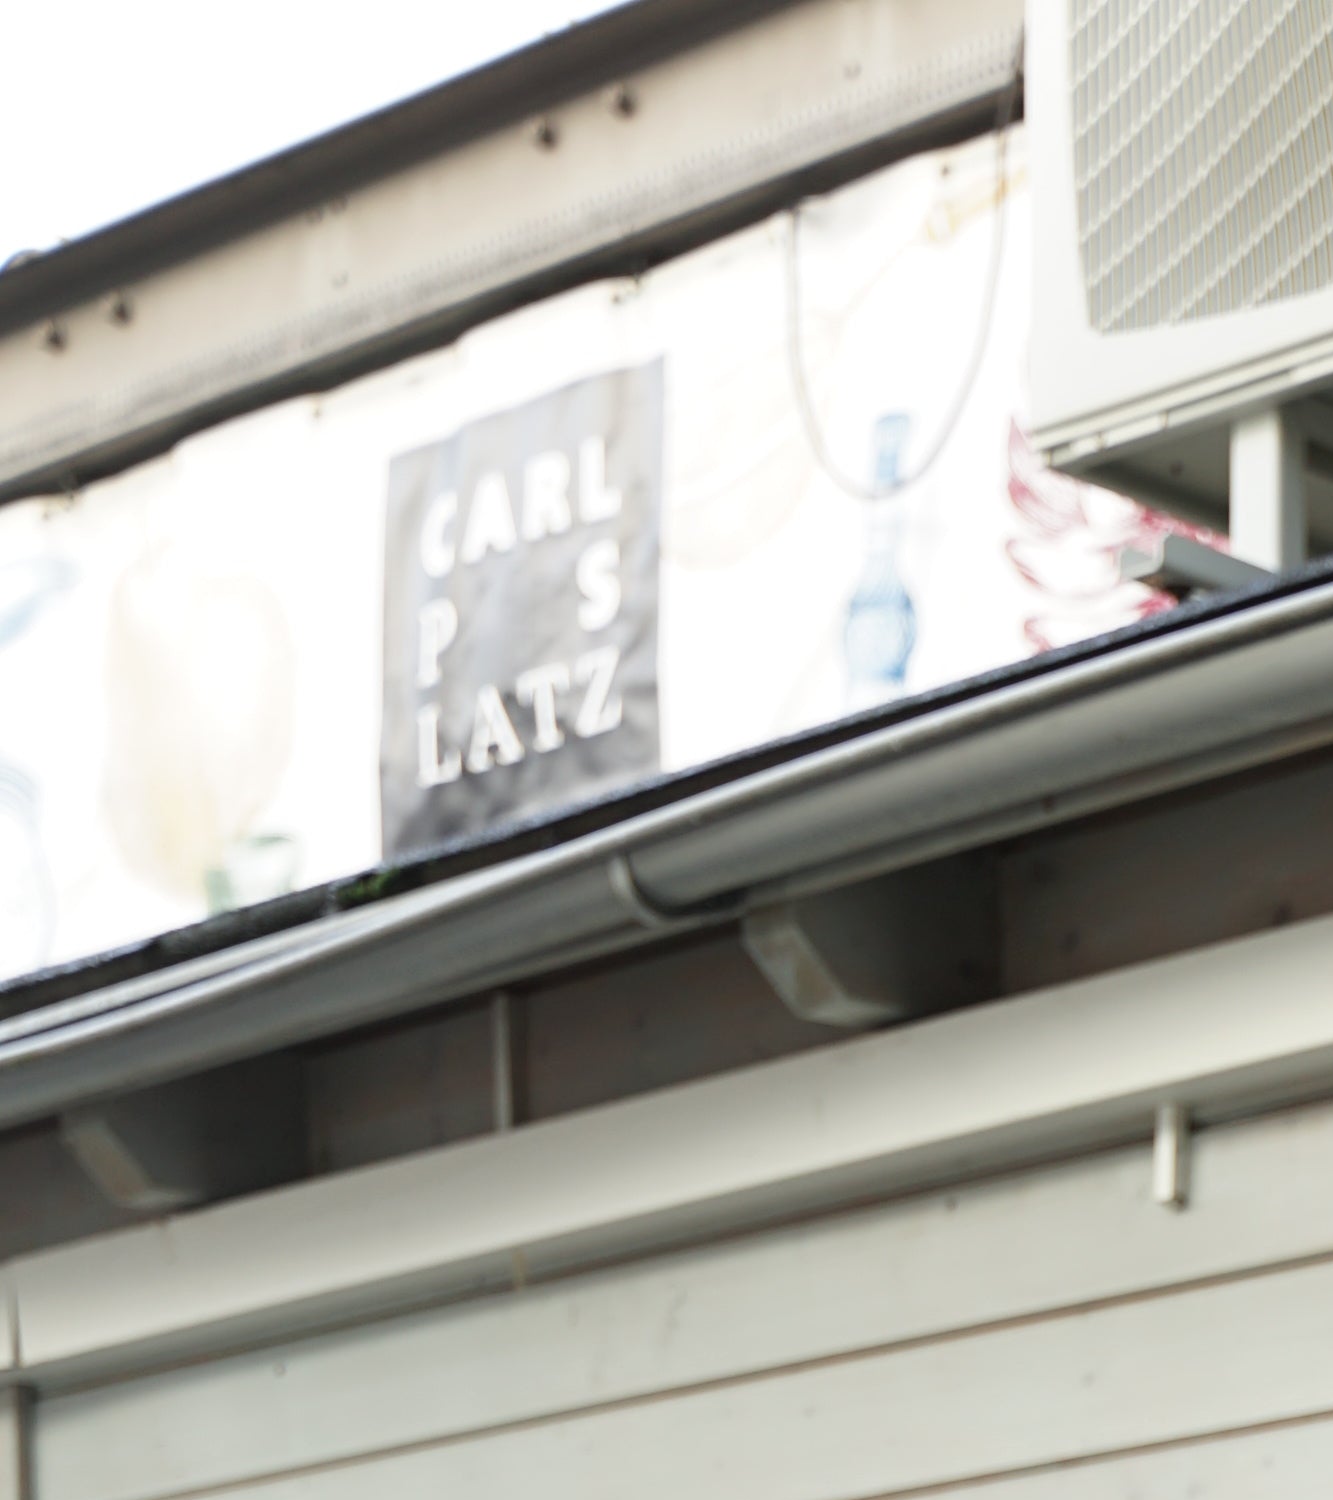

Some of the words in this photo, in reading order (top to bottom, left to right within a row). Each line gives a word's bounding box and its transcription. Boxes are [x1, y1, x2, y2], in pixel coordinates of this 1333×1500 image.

[420, 434, 623, 579] CARL
[416, 597, 459, 690] P
[575, 537, 622, 633] S
[416, 644, 624, 790] LATZ
